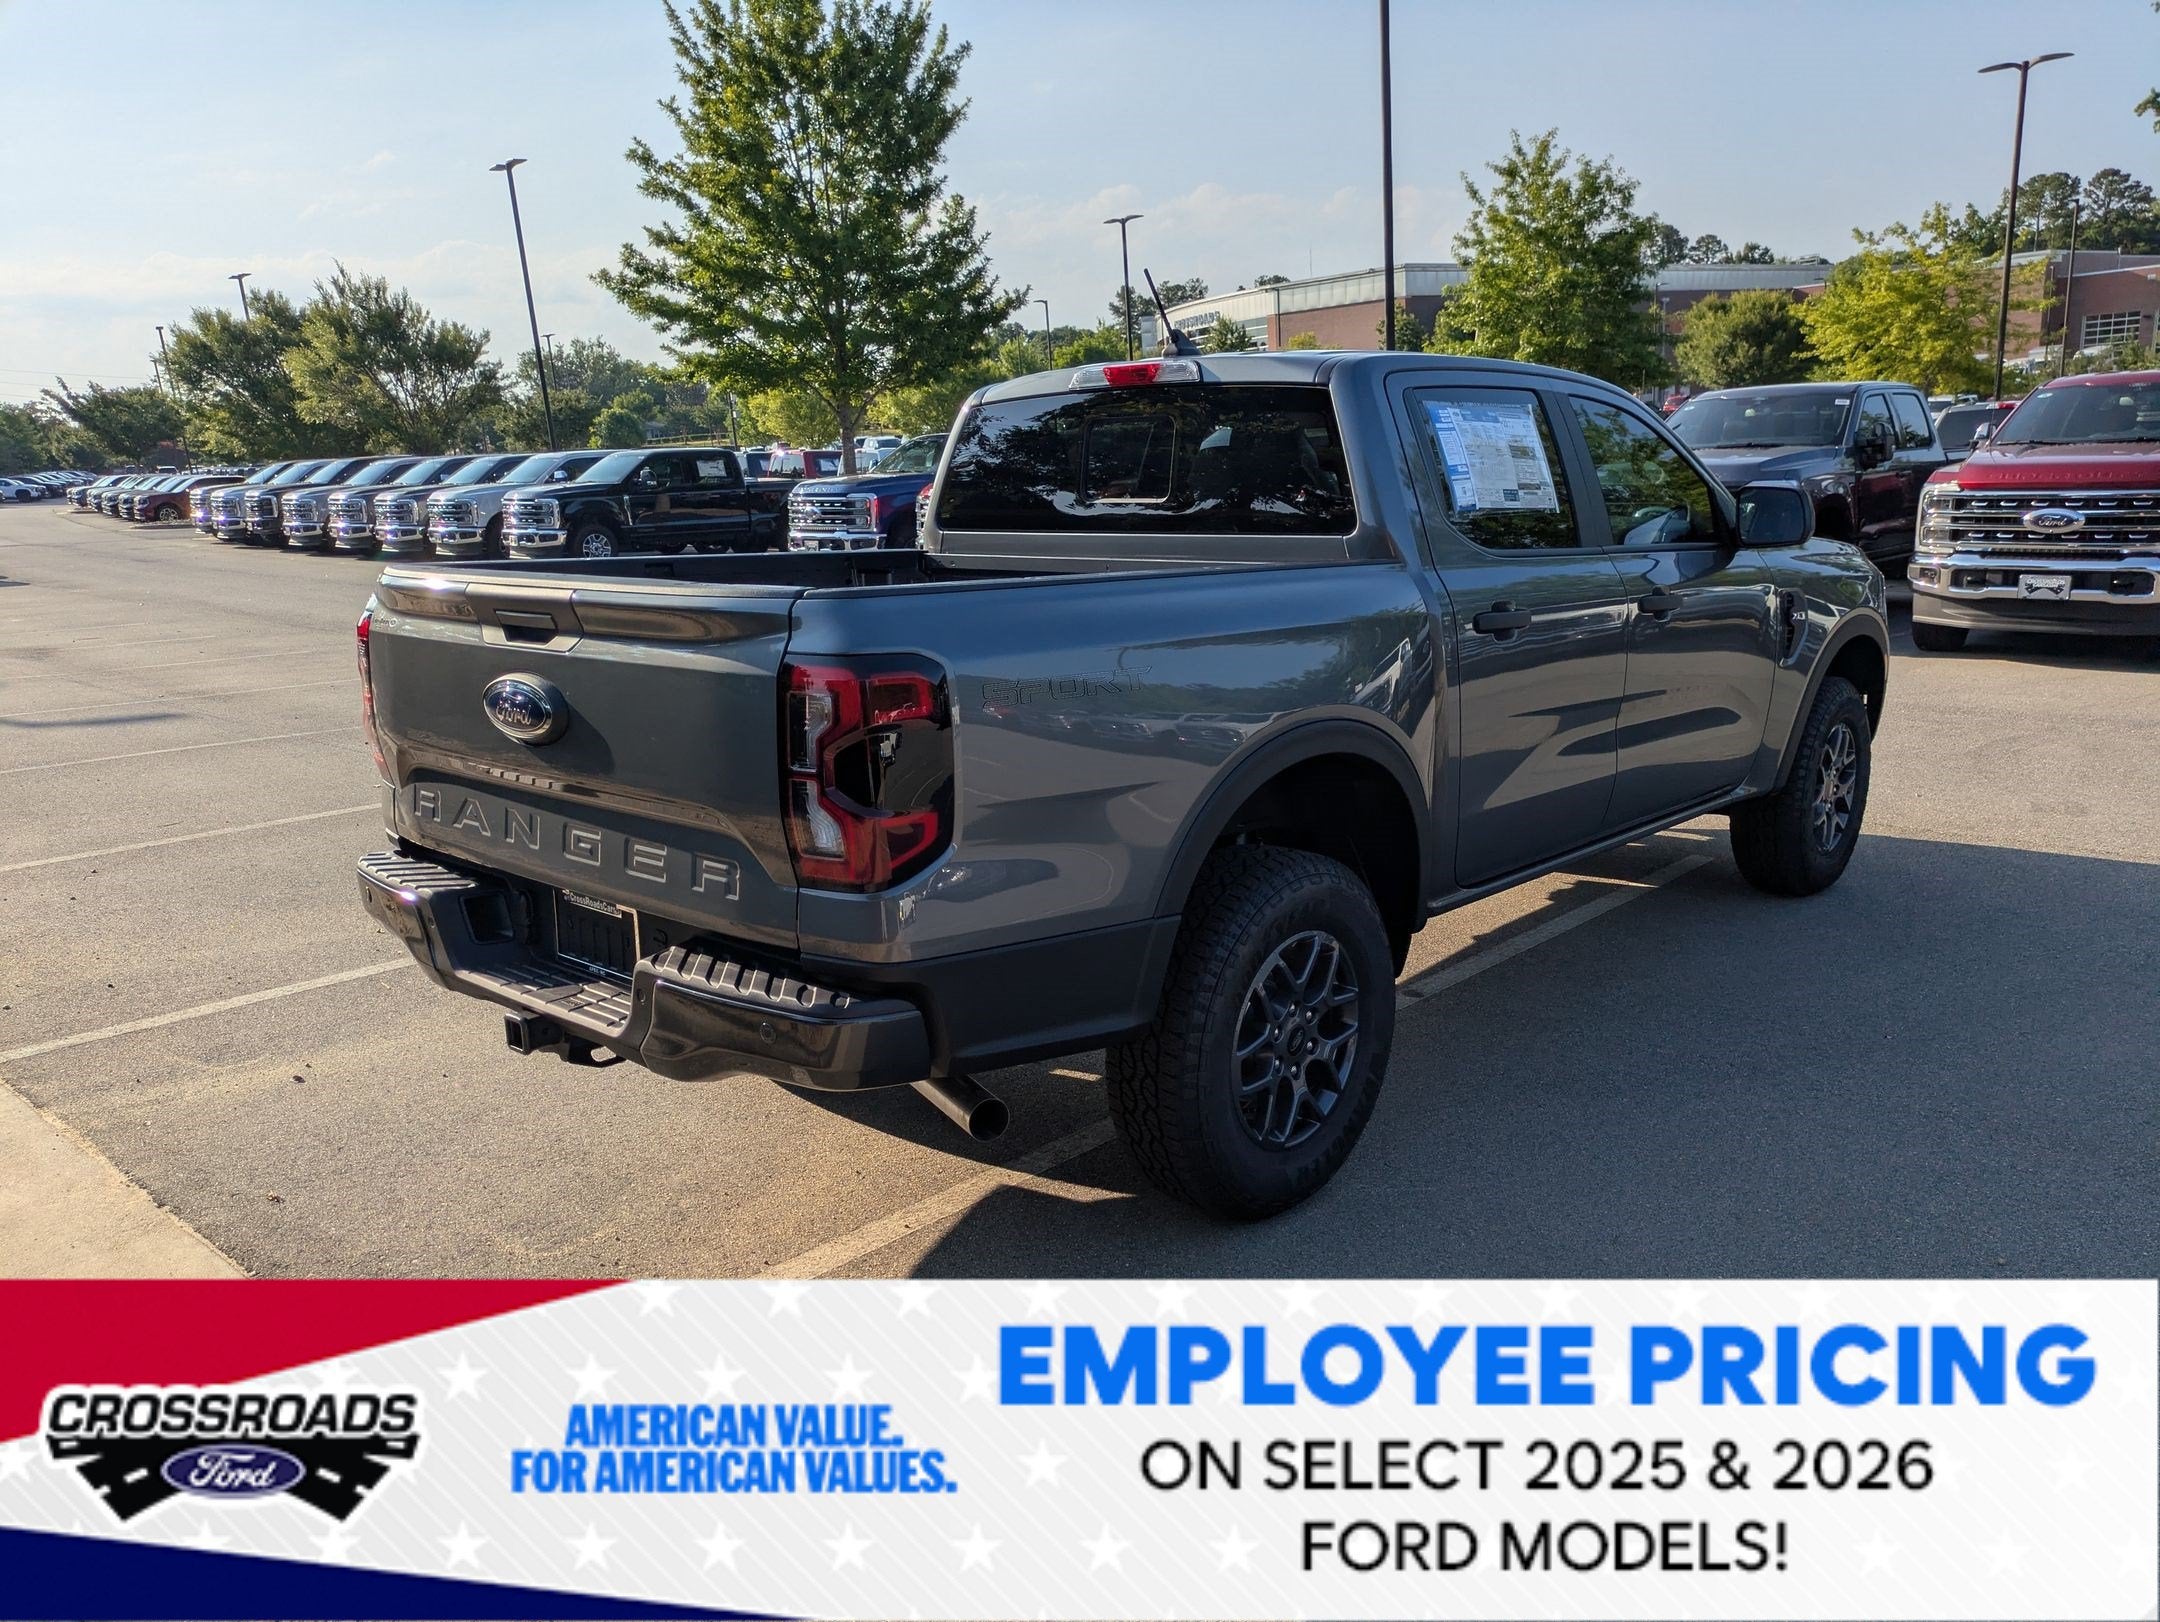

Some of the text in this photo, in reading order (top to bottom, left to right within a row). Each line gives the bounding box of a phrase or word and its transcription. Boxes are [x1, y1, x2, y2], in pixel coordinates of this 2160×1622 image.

[2038, 514, 2067, 527] Ford
[982, 665, 1152, 709] SPORT
[495, 692, 532, 726] Ford
[414, 783, 741, 901] RANGER
